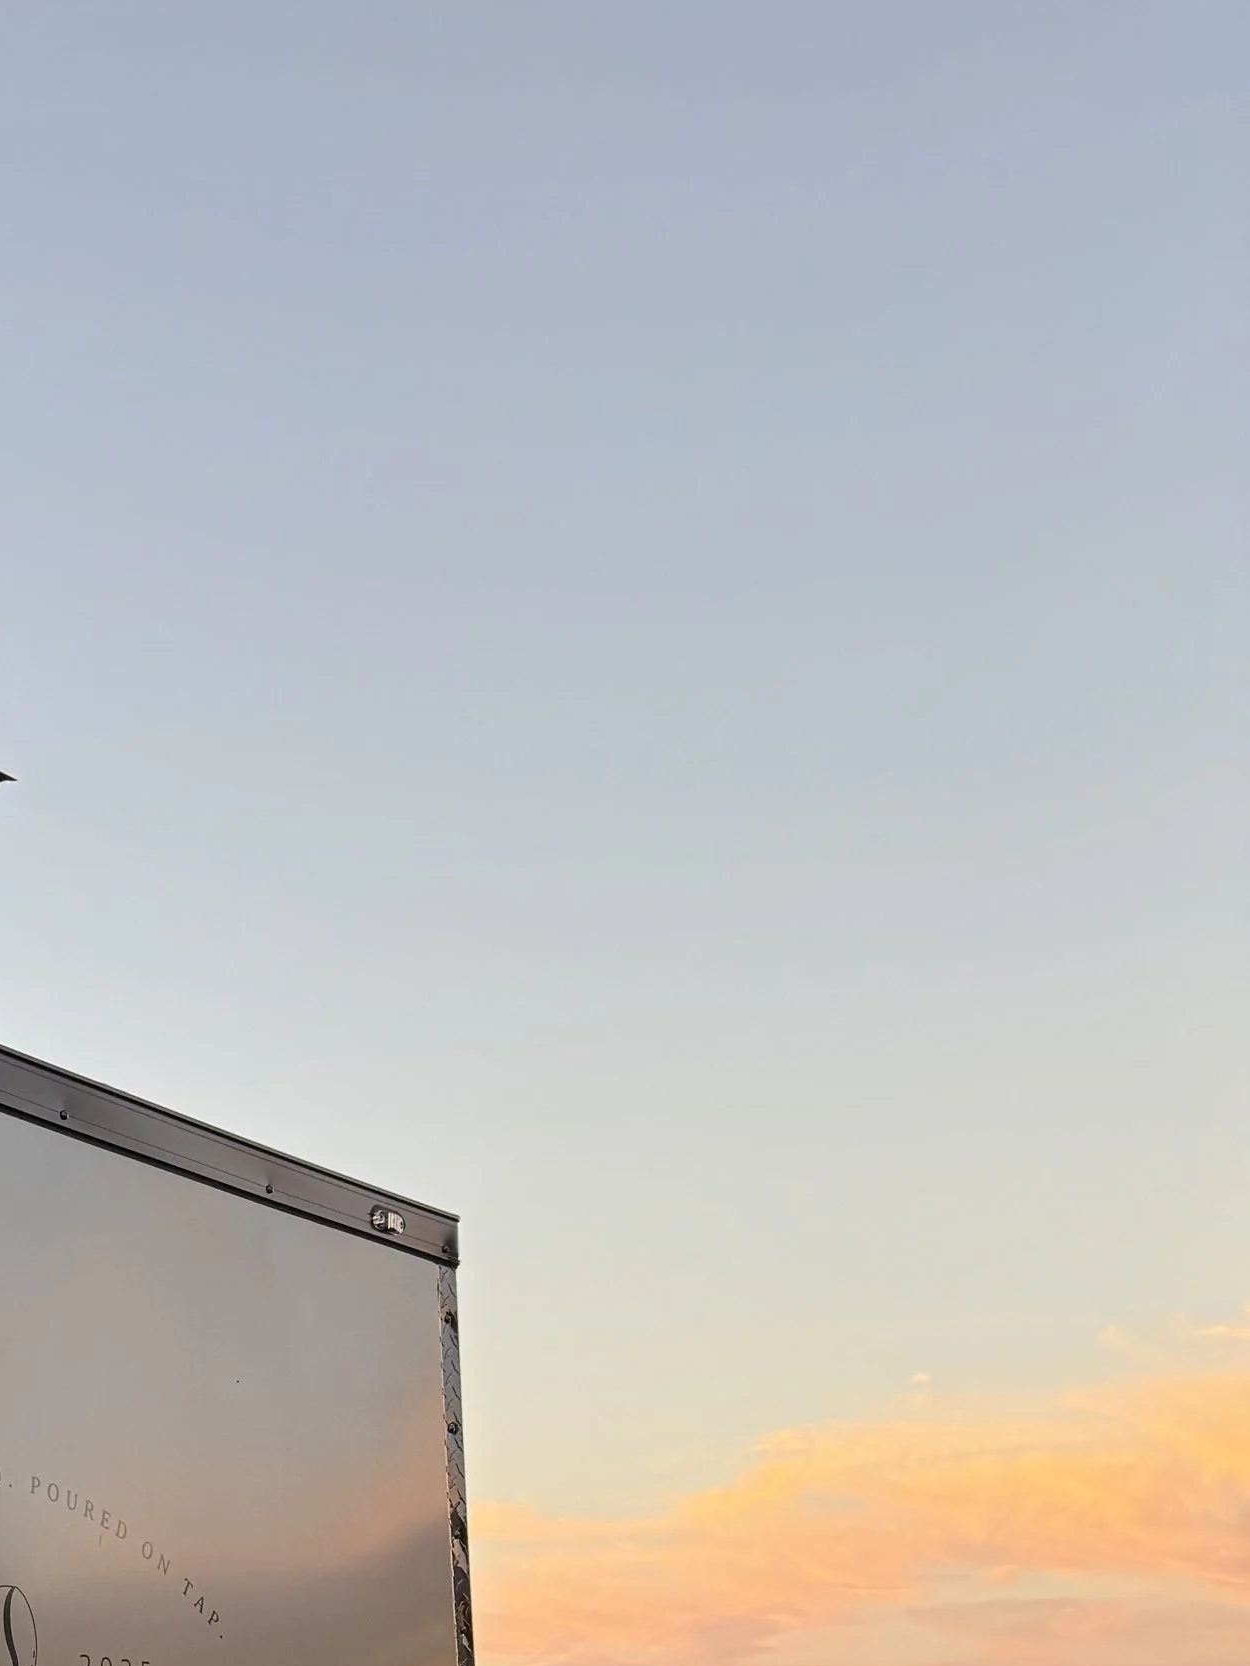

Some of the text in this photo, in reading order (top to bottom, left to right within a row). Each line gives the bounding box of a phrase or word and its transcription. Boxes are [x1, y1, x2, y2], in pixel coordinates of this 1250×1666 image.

[30, 1476, 128, 1540] POURED
[141, 1541, 171, 1575] ON
[182, 1577, 223, 1639] TAP.
